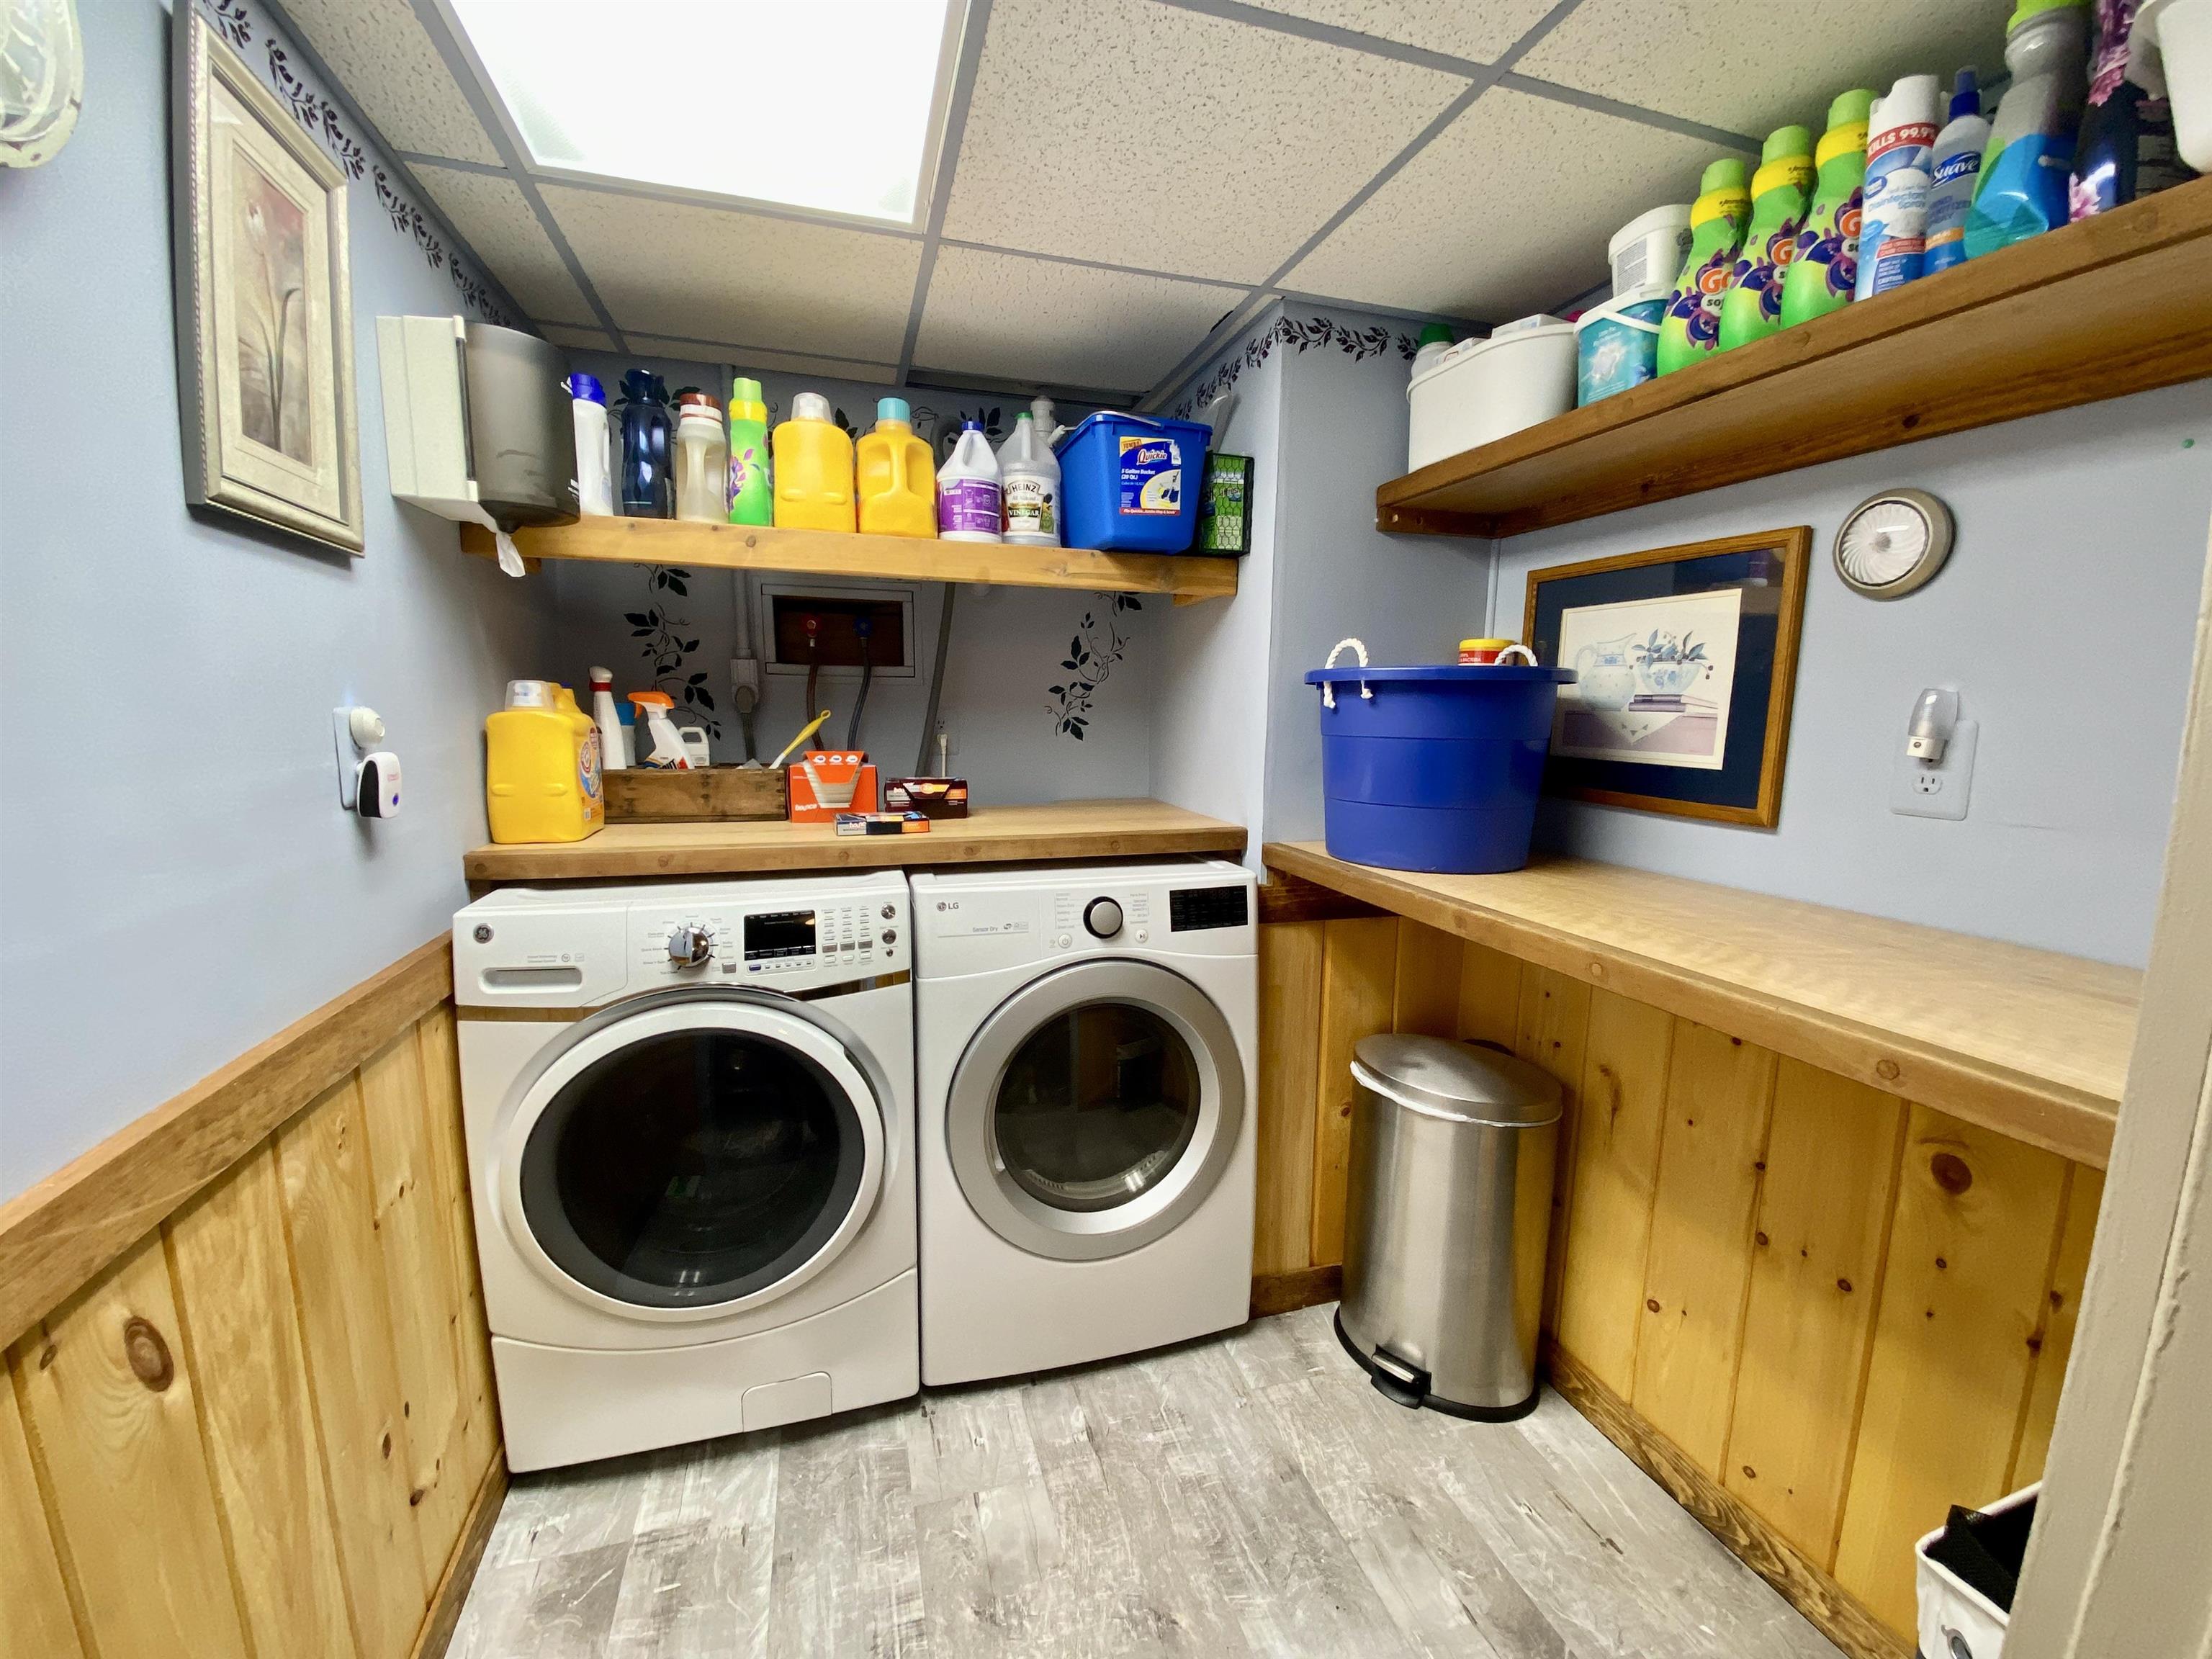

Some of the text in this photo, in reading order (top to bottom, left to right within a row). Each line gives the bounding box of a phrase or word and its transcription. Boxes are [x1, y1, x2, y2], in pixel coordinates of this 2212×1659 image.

[1867, 132, 1896, 157] KILLS
[1933, 158, 1979, 180] Suave
[1138, 449, 1167, 464] Quickie
[1012, 484, 1037, 493] HEINZ
[1008, 509, 1040, 518] VINEGAR
